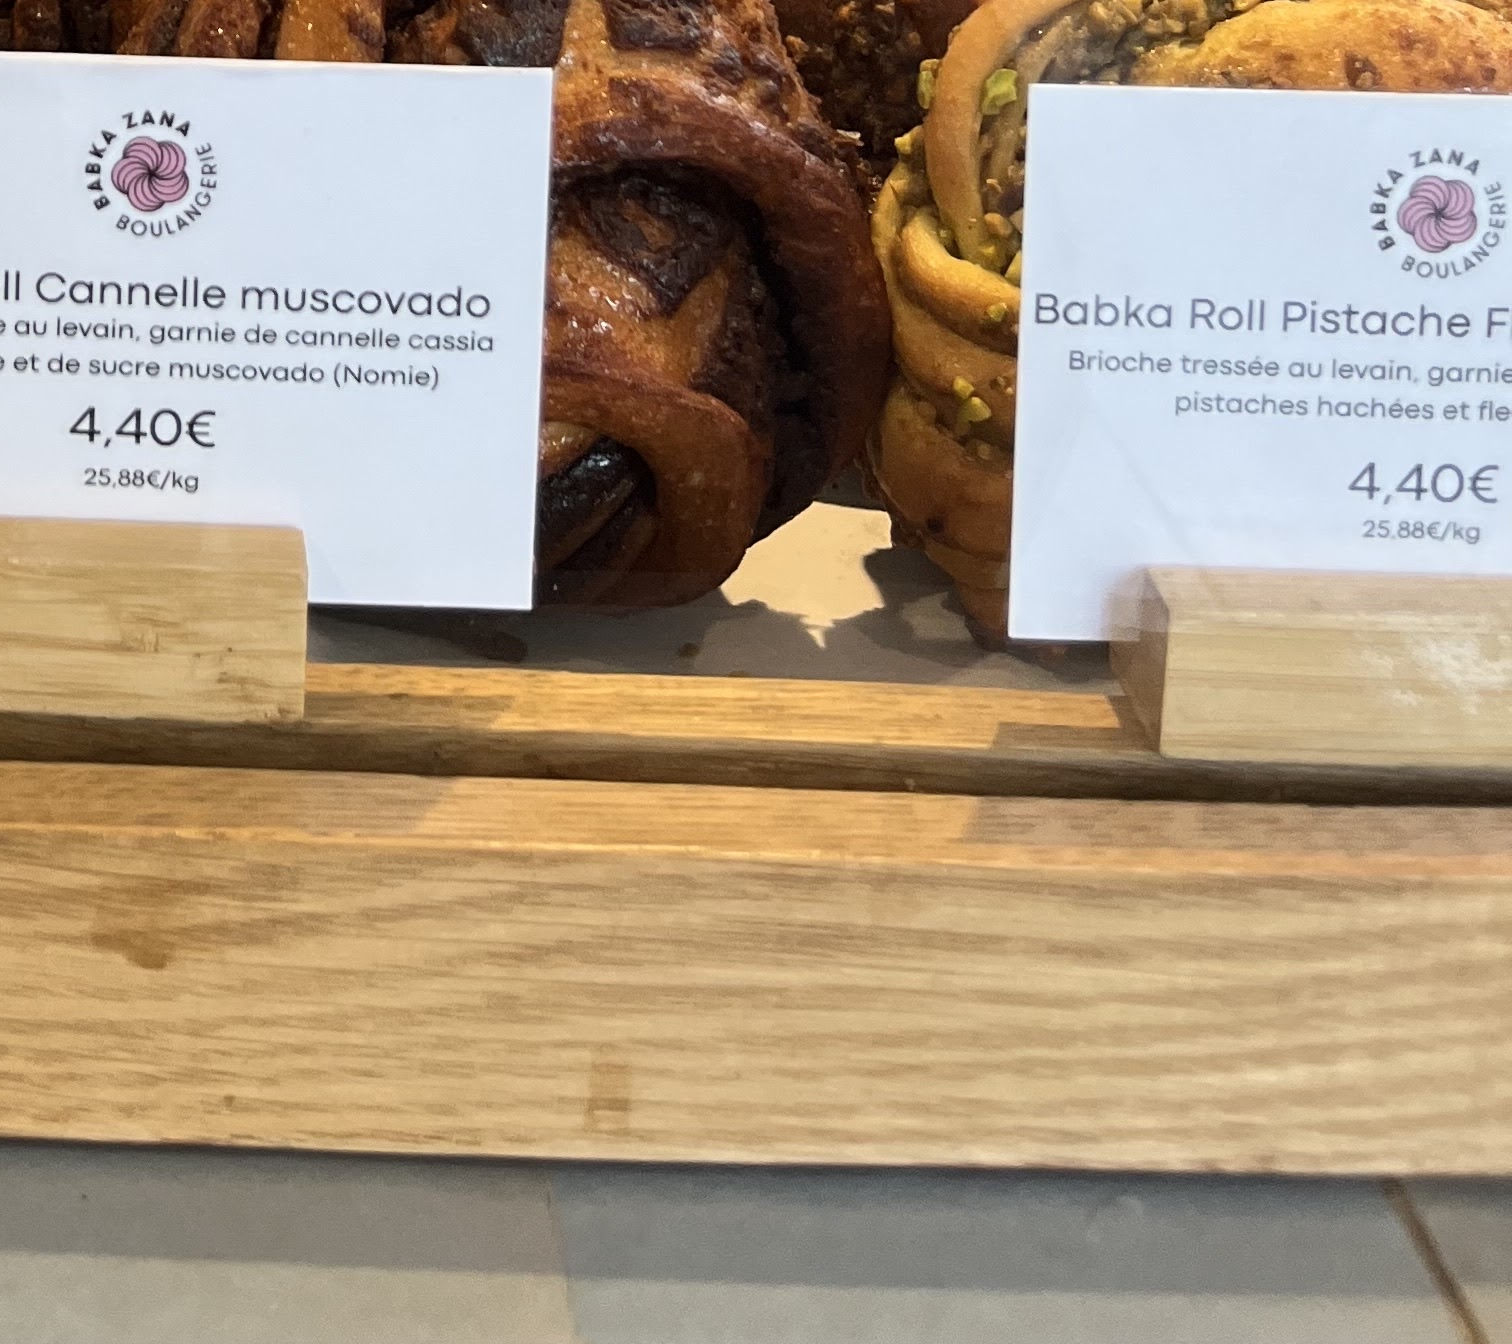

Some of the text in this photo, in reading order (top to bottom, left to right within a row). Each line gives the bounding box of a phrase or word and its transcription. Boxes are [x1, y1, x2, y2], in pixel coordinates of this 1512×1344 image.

[85, 109, 190, 210] BABKA ZANA
[116, 142, 217, 237] BOULANGERIE
[1369, 148, 1480, 251] BABKA ZANA
[1401, 181, 1506, 279] BOULANGERIE
[35, 272, 226, 311] Cannelle
[241, 285, 491, 319] muscovado
[1034, 293, 1173, 328] Babka
[1190, 298, 1266, 331] Roll
[1282, 300, 1471, 338] Pistache
[14, 320, 47, 338] au
[57, 316, 140, 342] levain,
[149, 322, 236, 347] garnie
[244, 323, 277, 345] de
[285, 328, 400, 350] cannelle
[408, 330, 493, 352] cassia
[13, 353, 40, 372] et
[47, 353, 80, 375] de
[89, 359, 160, 378] sucre
[169, 362, 325, 384] muscovado
[333, 362, 439, 391] (Nomie)
[1069, 350, 1172, 373] Brioche
[1179, 355, 1280, 377] tressée
[1288, 362, 1323, 378] au
[69, 406, 216, 449] 4,40€
[1175, 391, 1308, 416] pistaches
[1317, 395, 1434, 420] hachées
[1443, 401, 1470, 421] et
[84, 468, 199, 494] 25,88€/kg
[1348, 462, 1500, 505] 4,40€
